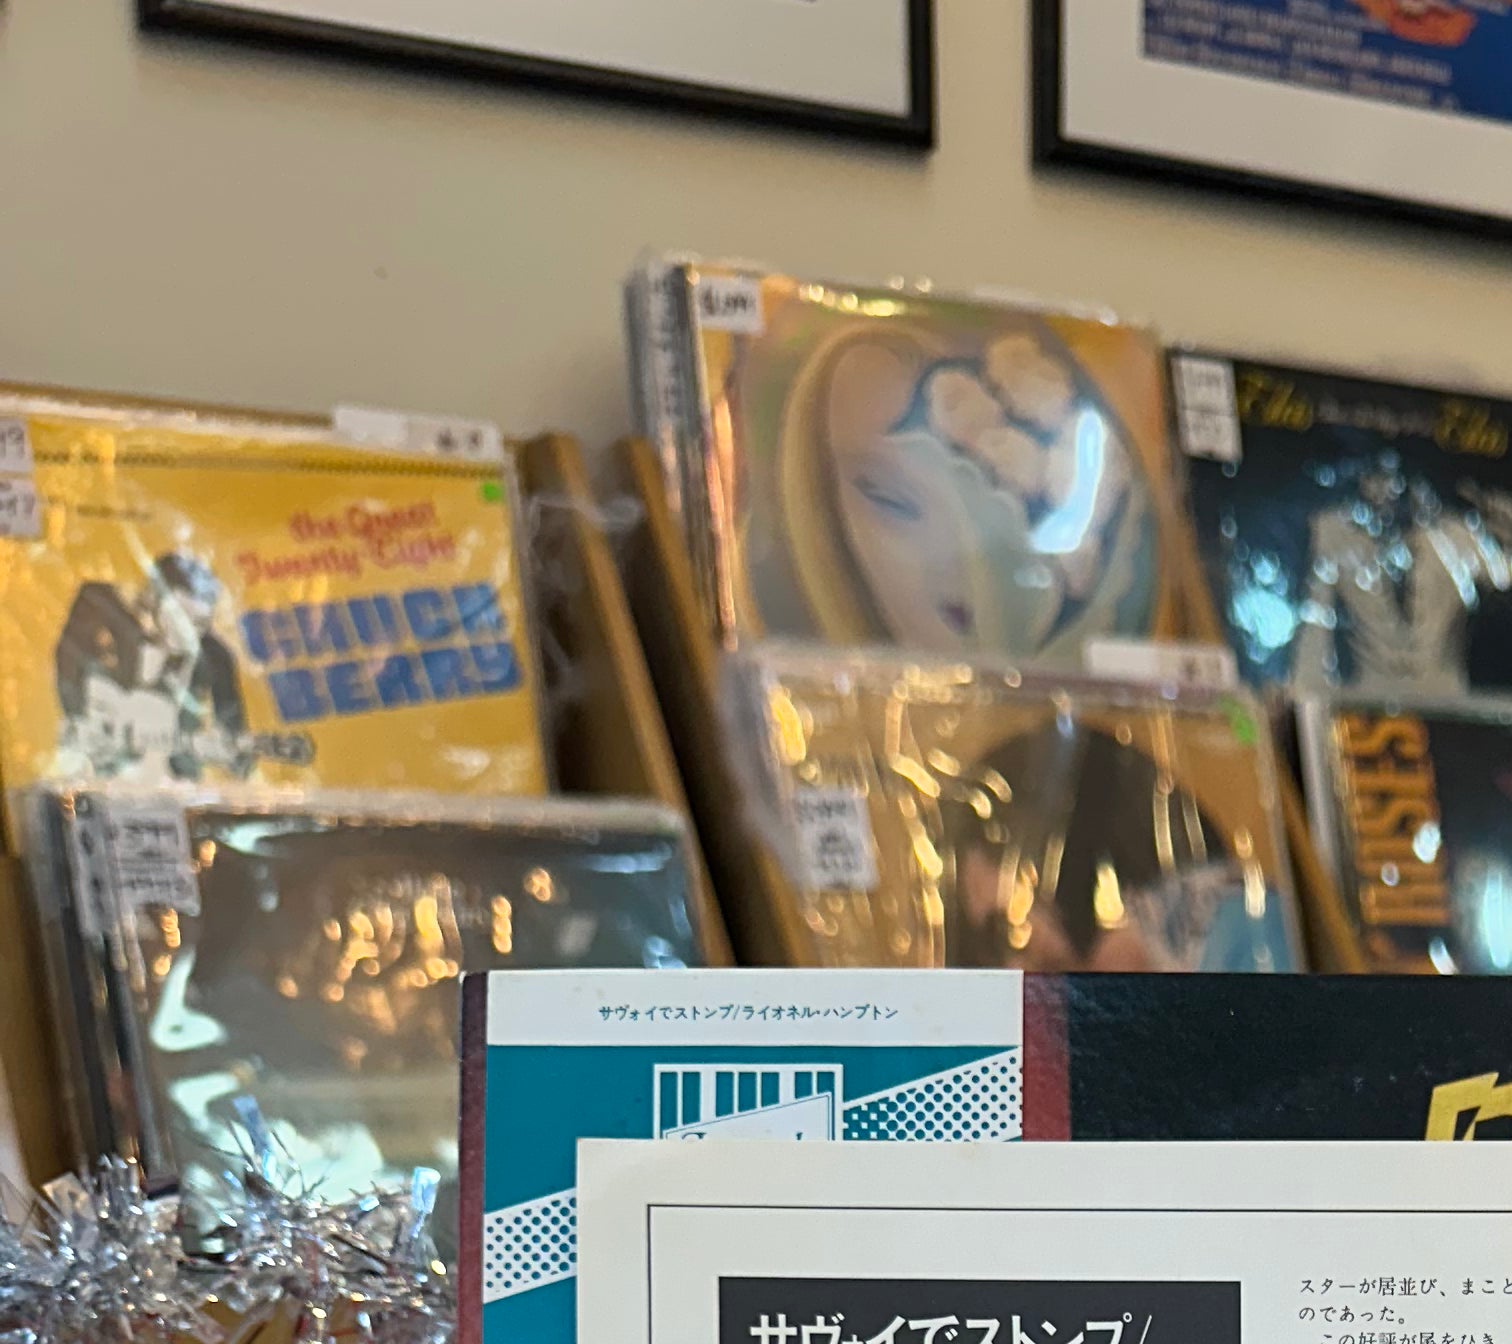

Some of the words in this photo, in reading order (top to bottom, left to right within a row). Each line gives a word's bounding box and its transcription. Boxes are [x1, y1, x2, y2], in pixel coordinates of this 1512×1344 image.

[241, 582, 507, 662] CHUCK
[268, 642, 523, 724] BERRY
[1299, 1305, 1404, 1324] のであった。
